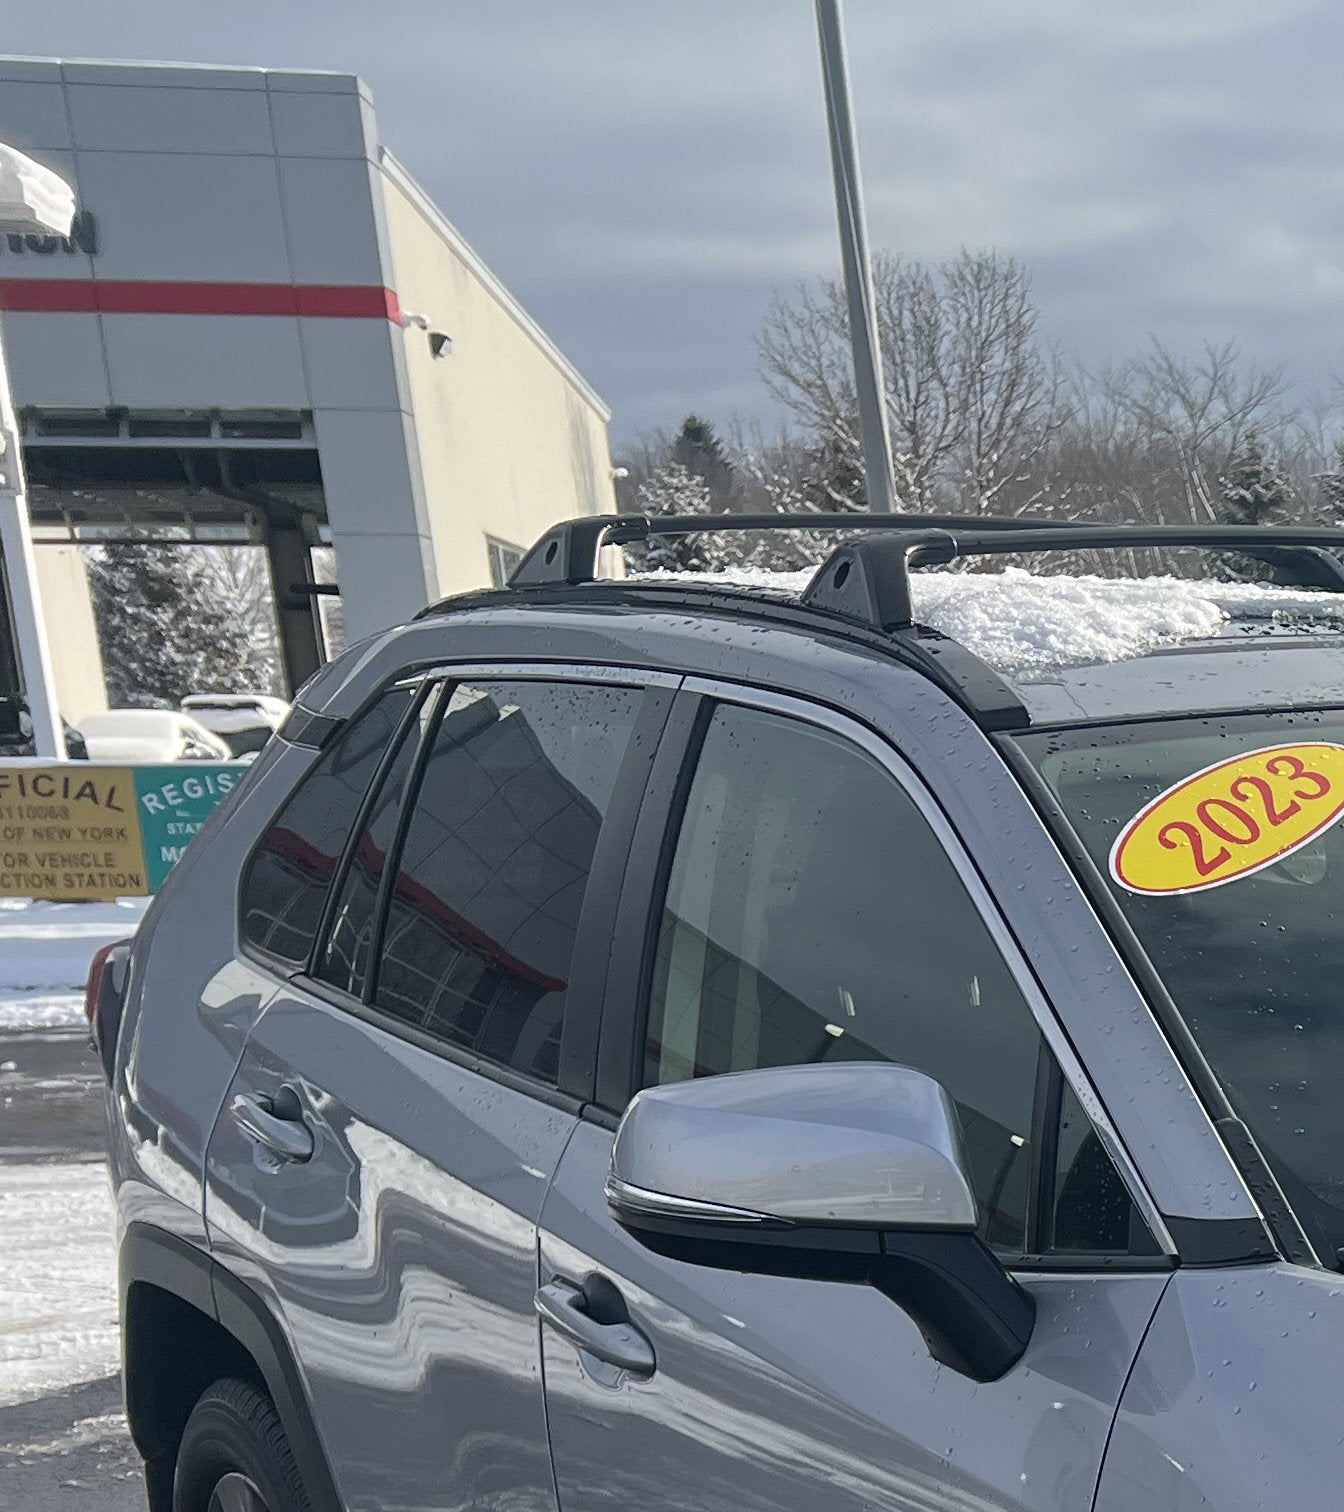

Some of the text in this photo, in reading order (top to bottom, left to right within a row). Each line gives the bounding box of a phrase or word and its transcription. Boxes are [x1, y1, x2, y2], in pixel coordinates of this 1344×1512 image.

[141, 773, 243, 815] REGIS
[1158, 756, 1331, 876] 2023
[3, 826, 129, 841] OF NEW YORK
[0, 852, 116, 868] OR VEHICLE
[63, 872, 141, 889] STATION
